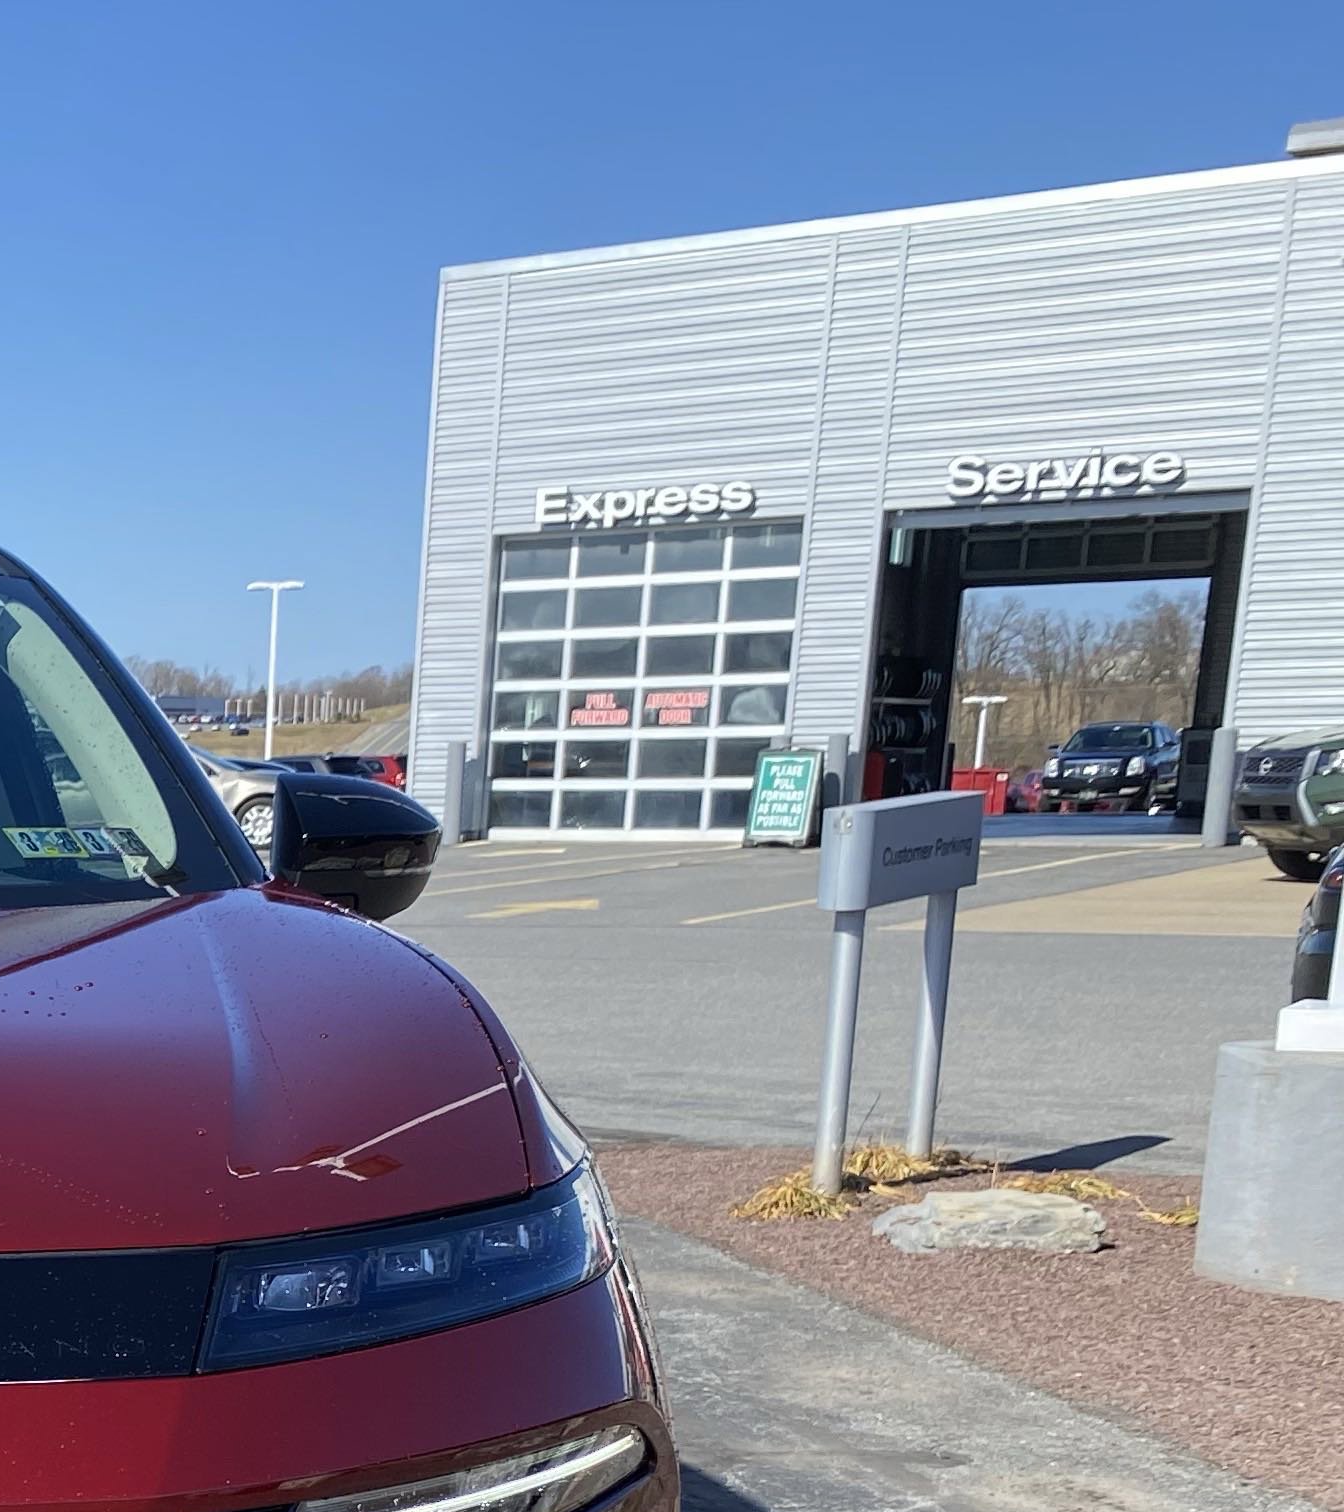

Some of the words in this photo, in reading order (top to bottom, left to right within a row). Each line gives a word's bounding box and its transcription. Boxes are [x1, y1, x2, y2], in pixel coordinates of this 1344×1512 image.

[945, 446, 1183, 497] Service
[535, 481, 754, 528] Express
[586, 693, 617, 709] PULL
[571, 708, 629, 726] FORWARD
[770, 765, 804, 777] PLEASE
[773, 778, 795, 790] PULL
[760, 790, 804, 802] FORWARD
[758, 803, 769, 814] AS
[771, 803, 789, 814] FAR
[790, 803, 802, 814] AS
[756, 815, 799, 827] POSSIBLE
[18, 831, 39, 852] 3
[82, 831, 105, 851] 3
[883, 845, 934, 867] Customer
[935, 838, 973, 857] Parking
